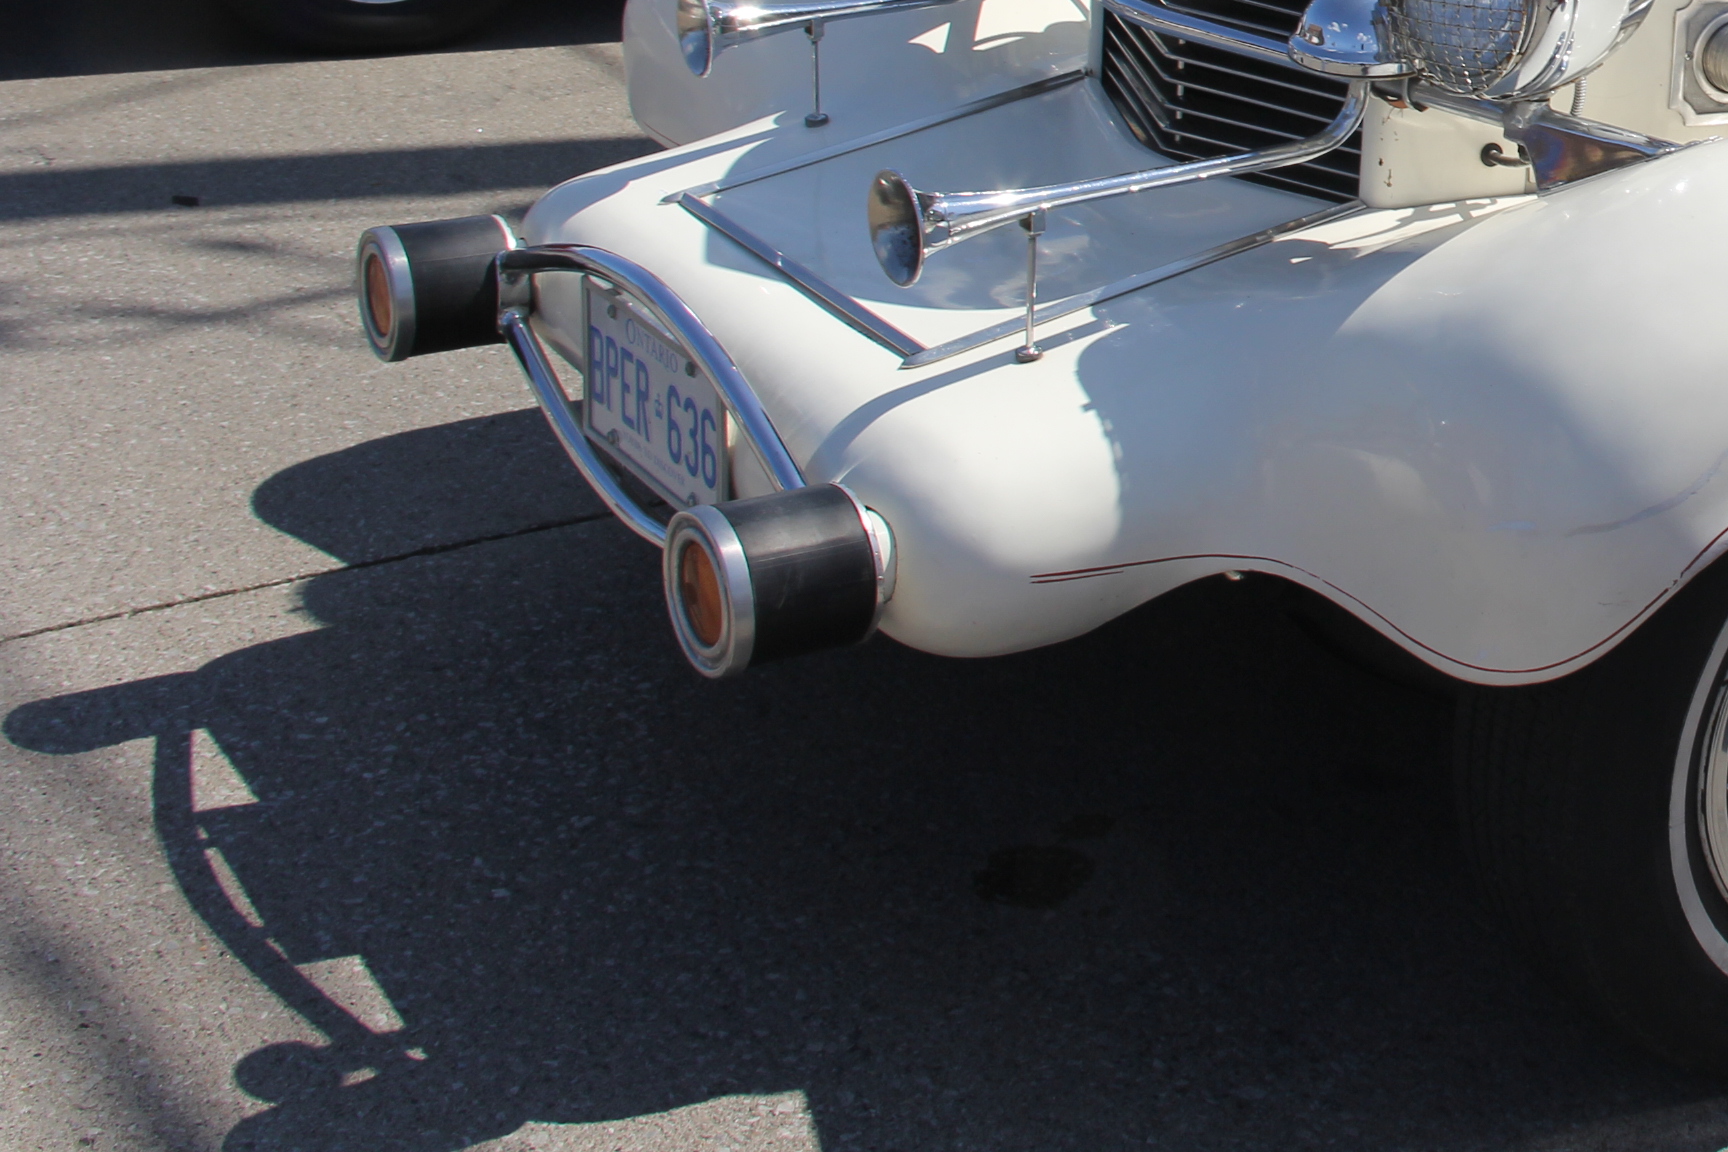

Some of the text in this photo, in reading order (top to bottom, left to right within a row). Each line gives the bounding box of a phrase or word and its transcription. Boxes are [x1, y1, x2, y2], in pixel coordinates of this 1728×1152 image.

[626, 318, 678, 374] ONTARIO
[590, 325, 717, 489] BPER 636
